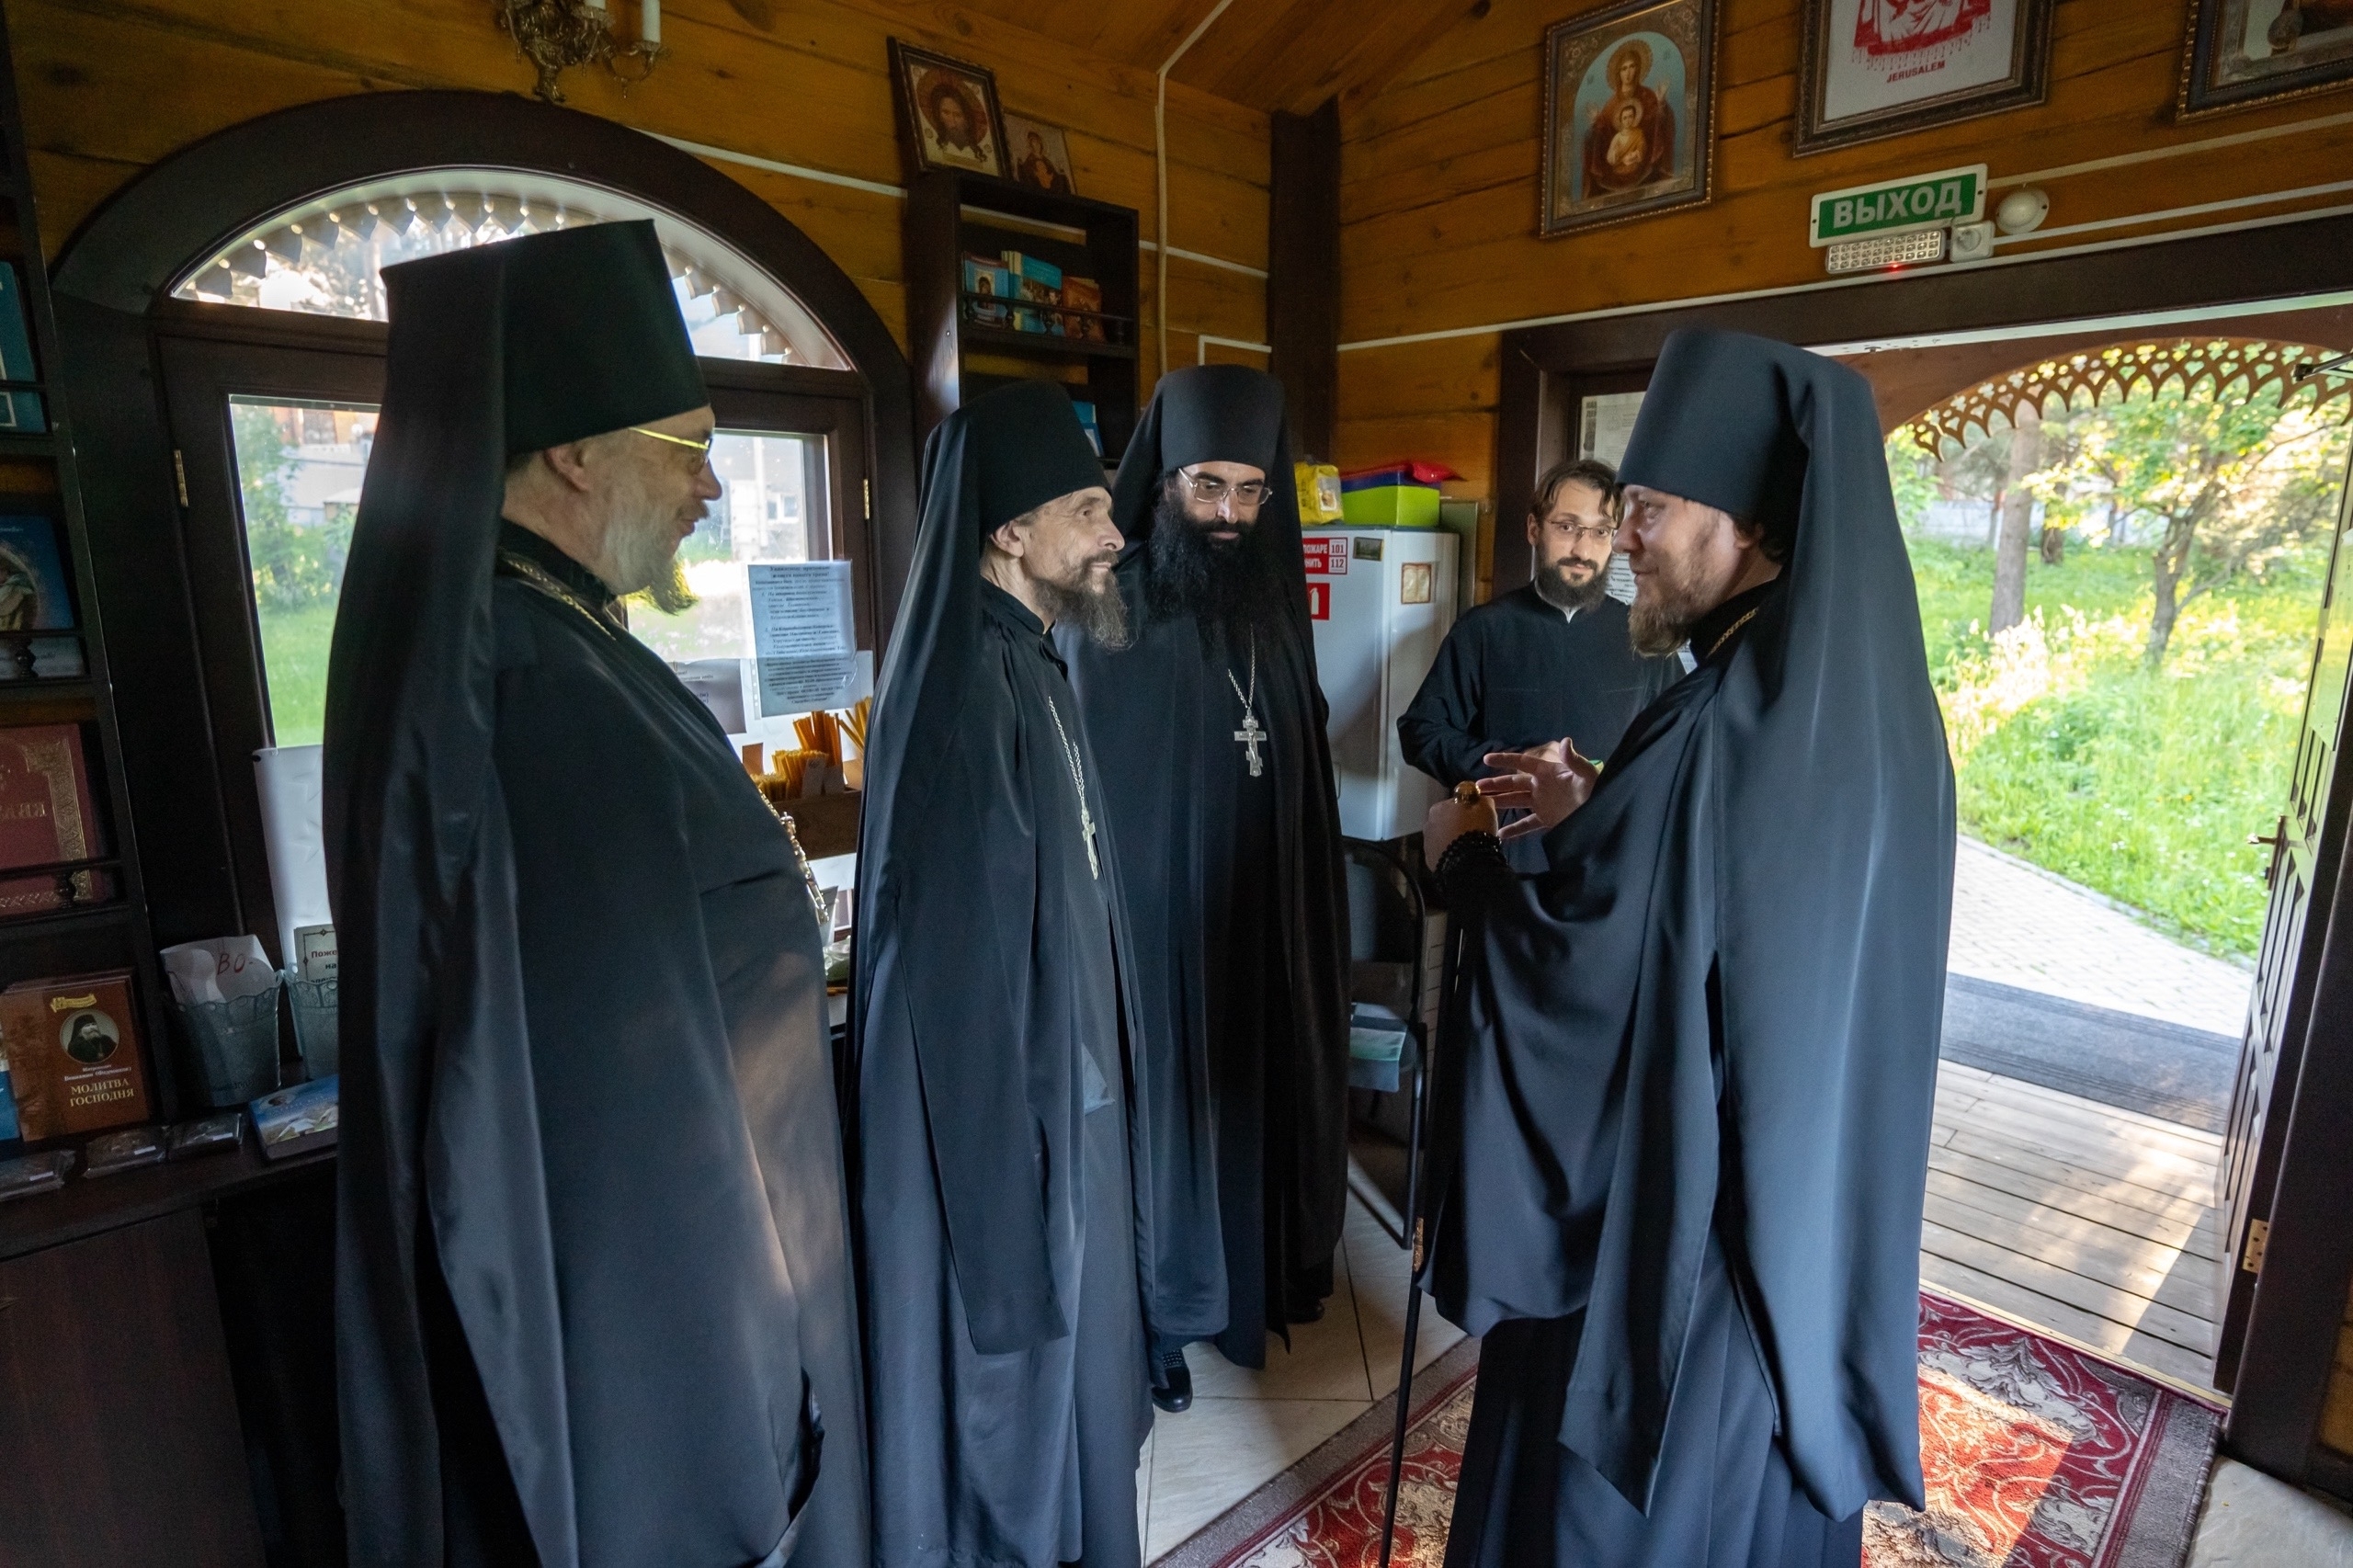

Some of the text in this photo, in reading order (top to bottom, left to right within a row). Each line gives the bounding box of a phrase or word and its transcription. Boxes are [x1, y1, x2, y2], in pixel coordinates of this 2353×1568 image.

[1887, 60, 1946, 84] JERUSALEM
[1833, 179, 1962, 229] ВЫХОД
[1331, 544, 1344, 554] 101
[1304, 558, 1345, 569] НИТЬ 112
[311, 949, 338, 959] Поже
[70, 1078, 130, 1095] МОЛИТВА
[69, 1088, 135, 1108] ГОСПОДНЯ
